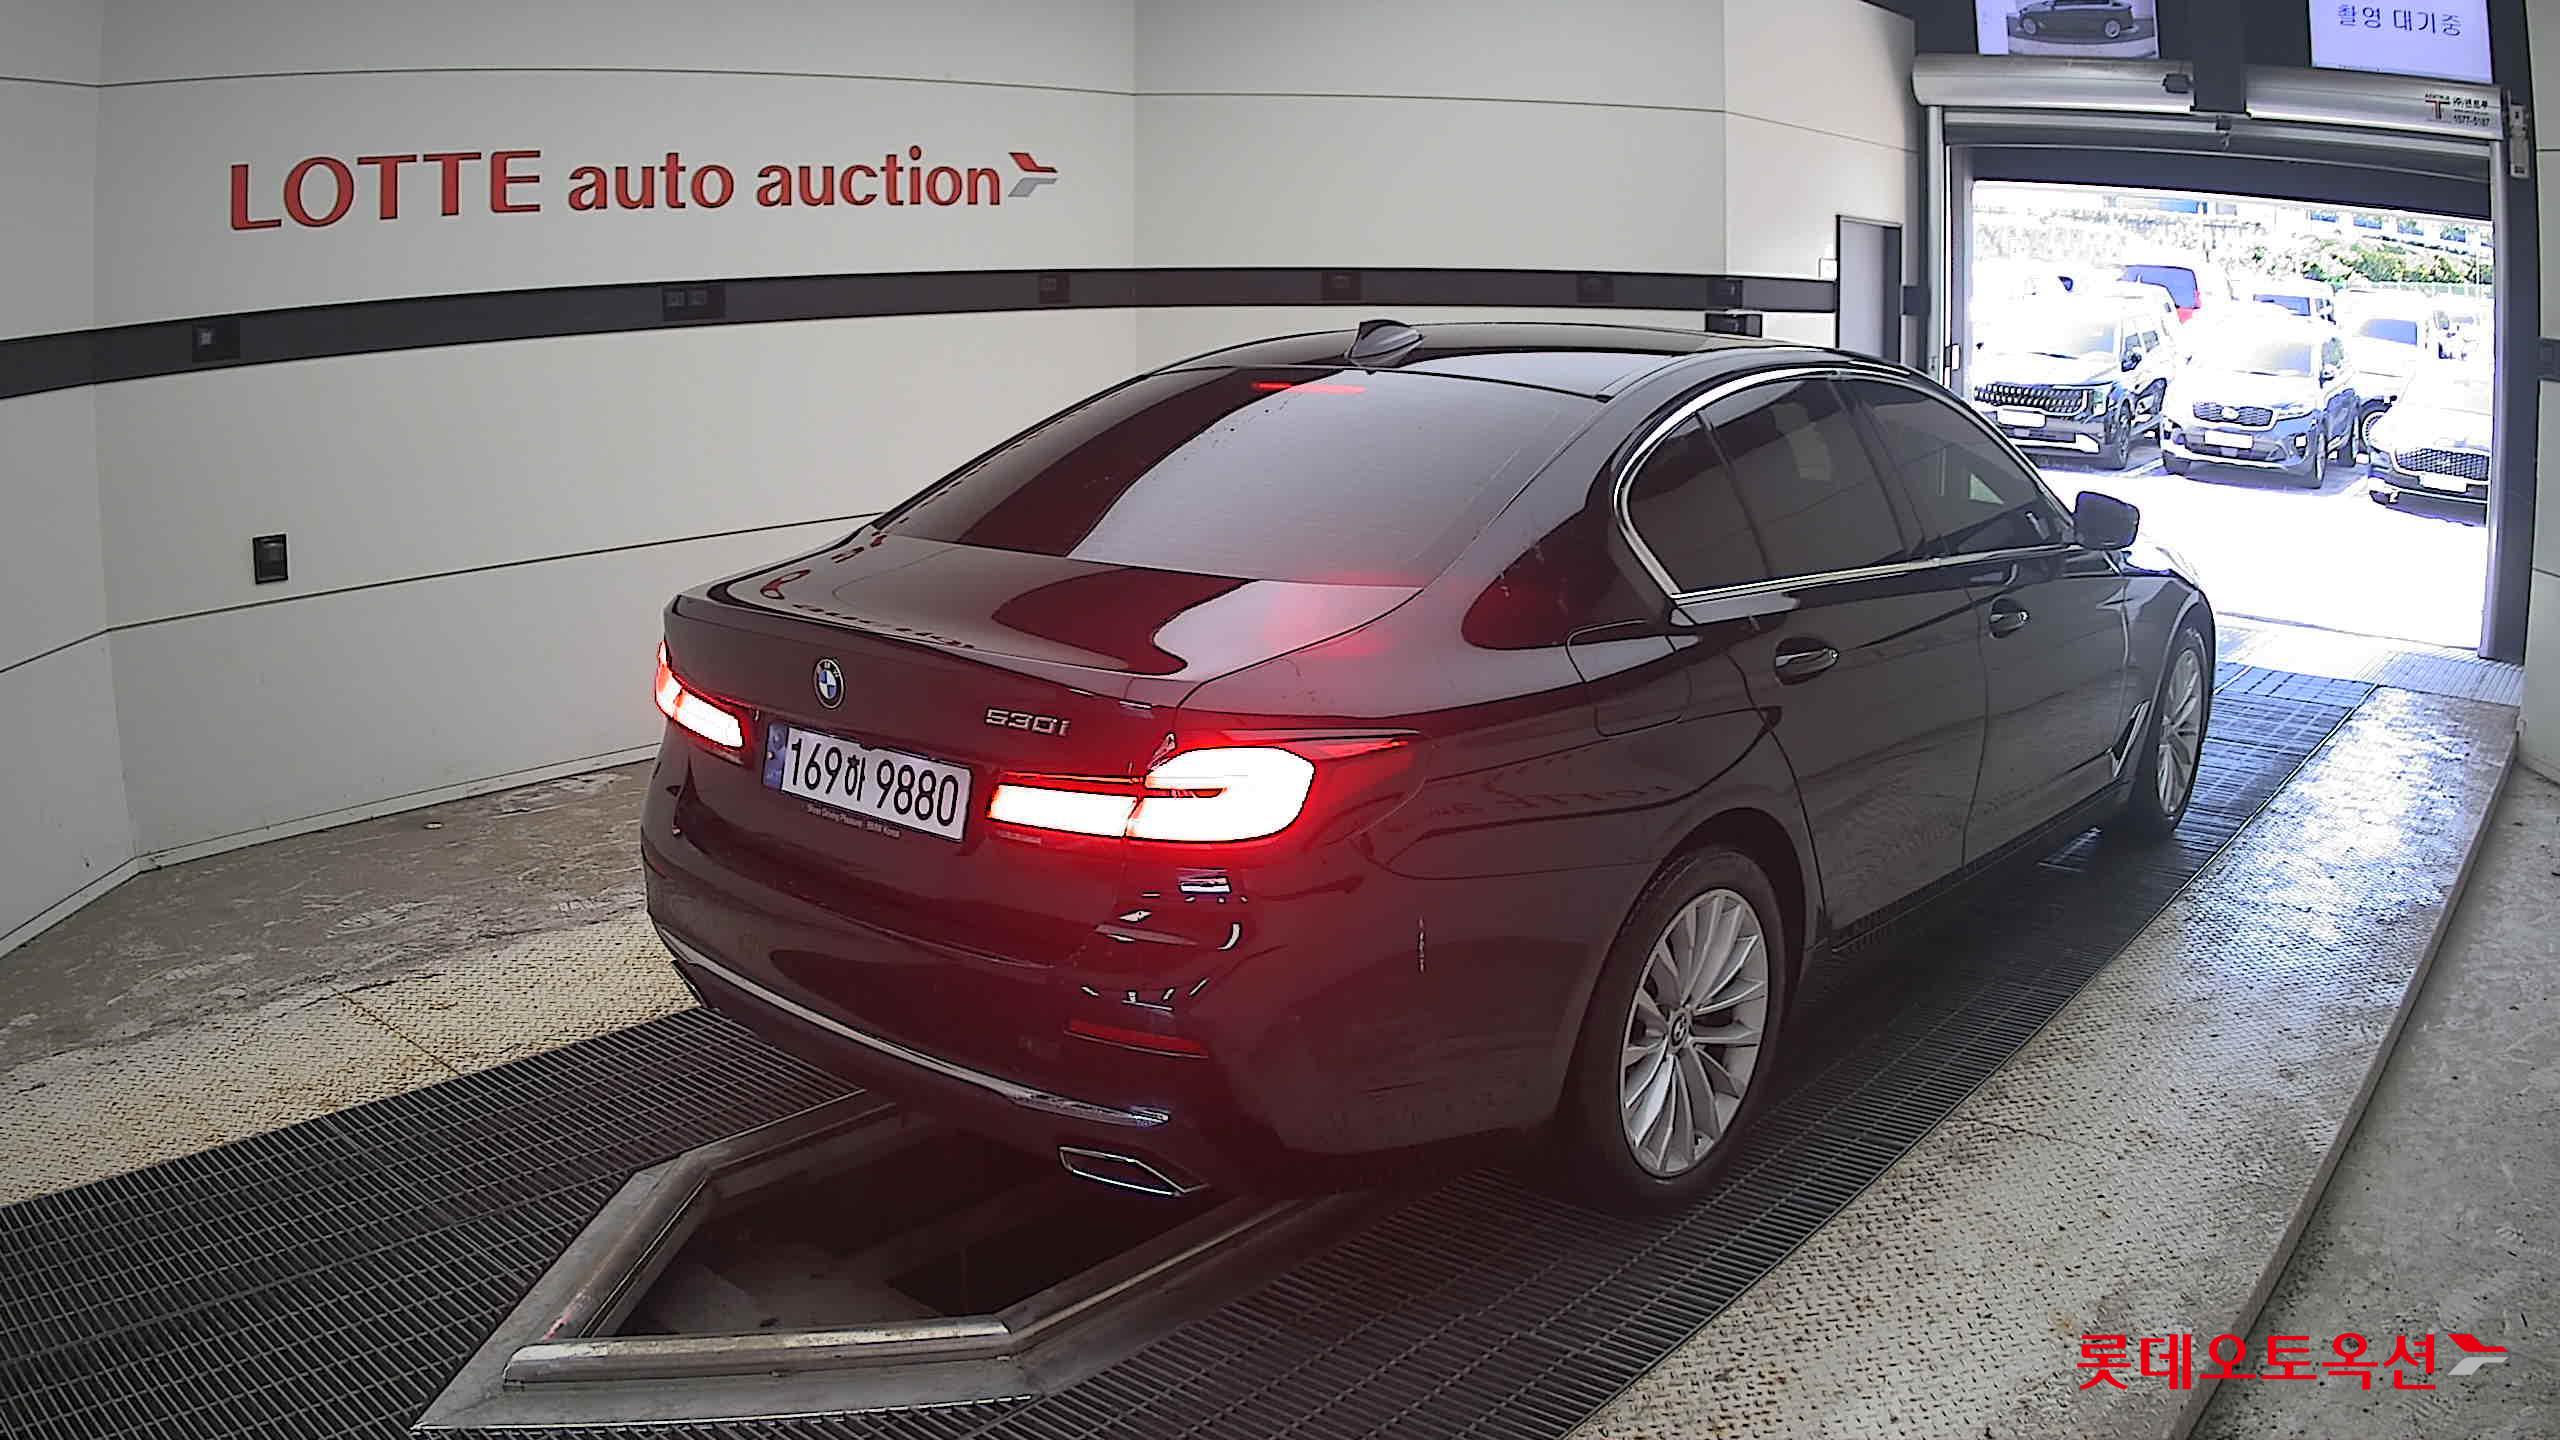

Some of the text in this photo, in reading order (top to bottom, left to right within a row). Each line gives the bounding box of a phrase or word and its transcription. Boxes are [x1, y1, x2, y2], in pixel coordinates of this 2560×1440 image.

[2393, 9, 2461, 36] 대기중
[230, 145, 1000, 231] LOTTE auto auction
[985, 708, 1070, 736] 530i
[791, 738, 866, 801] 169하
[876, 759, 959, 827] 9880
